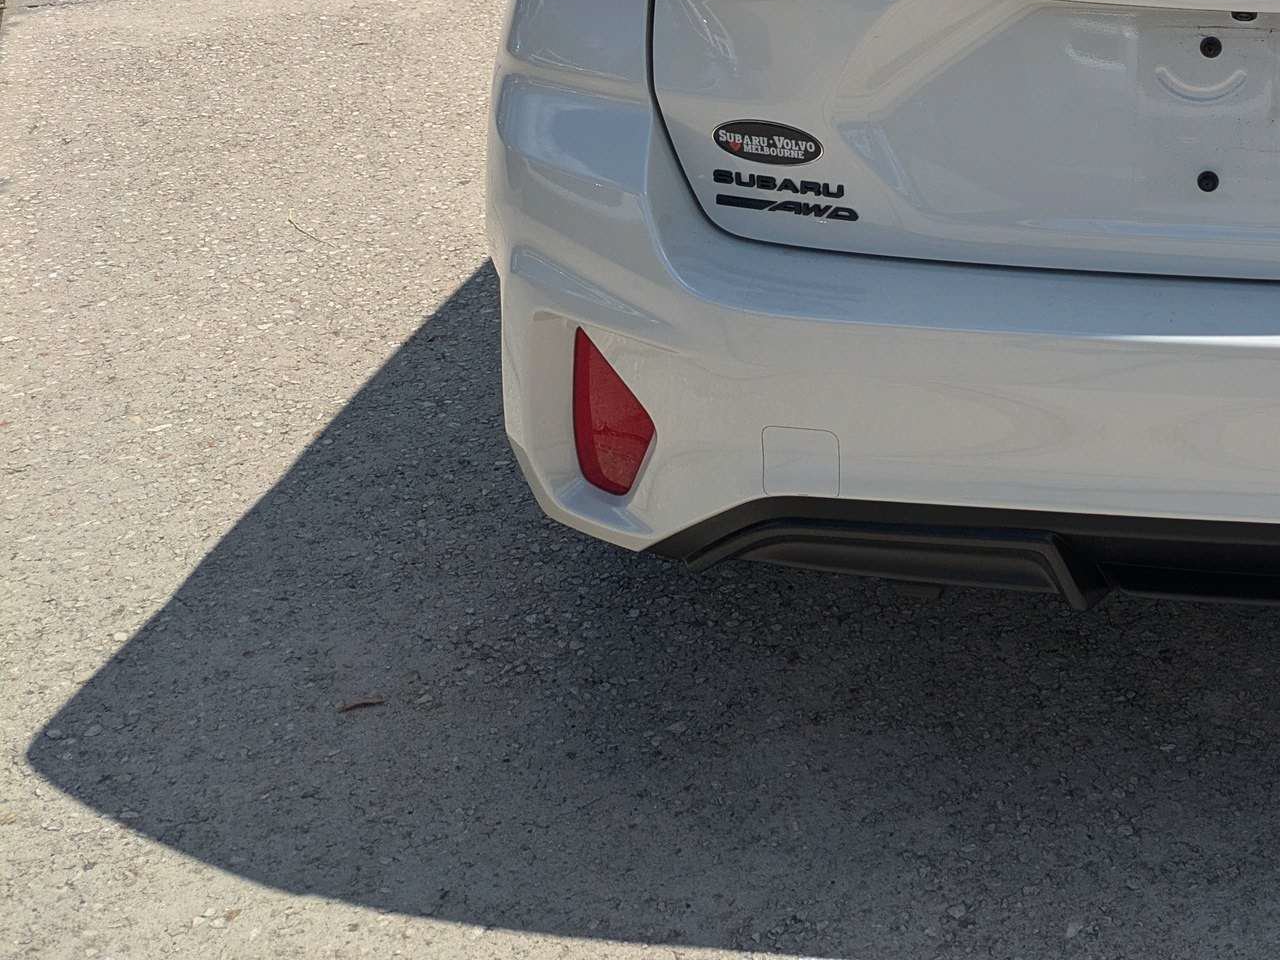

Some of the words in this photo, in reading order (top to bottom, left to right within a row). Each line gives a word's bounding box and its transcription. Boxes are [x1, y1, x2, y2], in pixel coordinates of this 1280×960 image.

[743, 145, 805, 160] MELBOURNE
[713, 169, 845, 199] SUBARU
[768, 200, 860, 222] AWD
